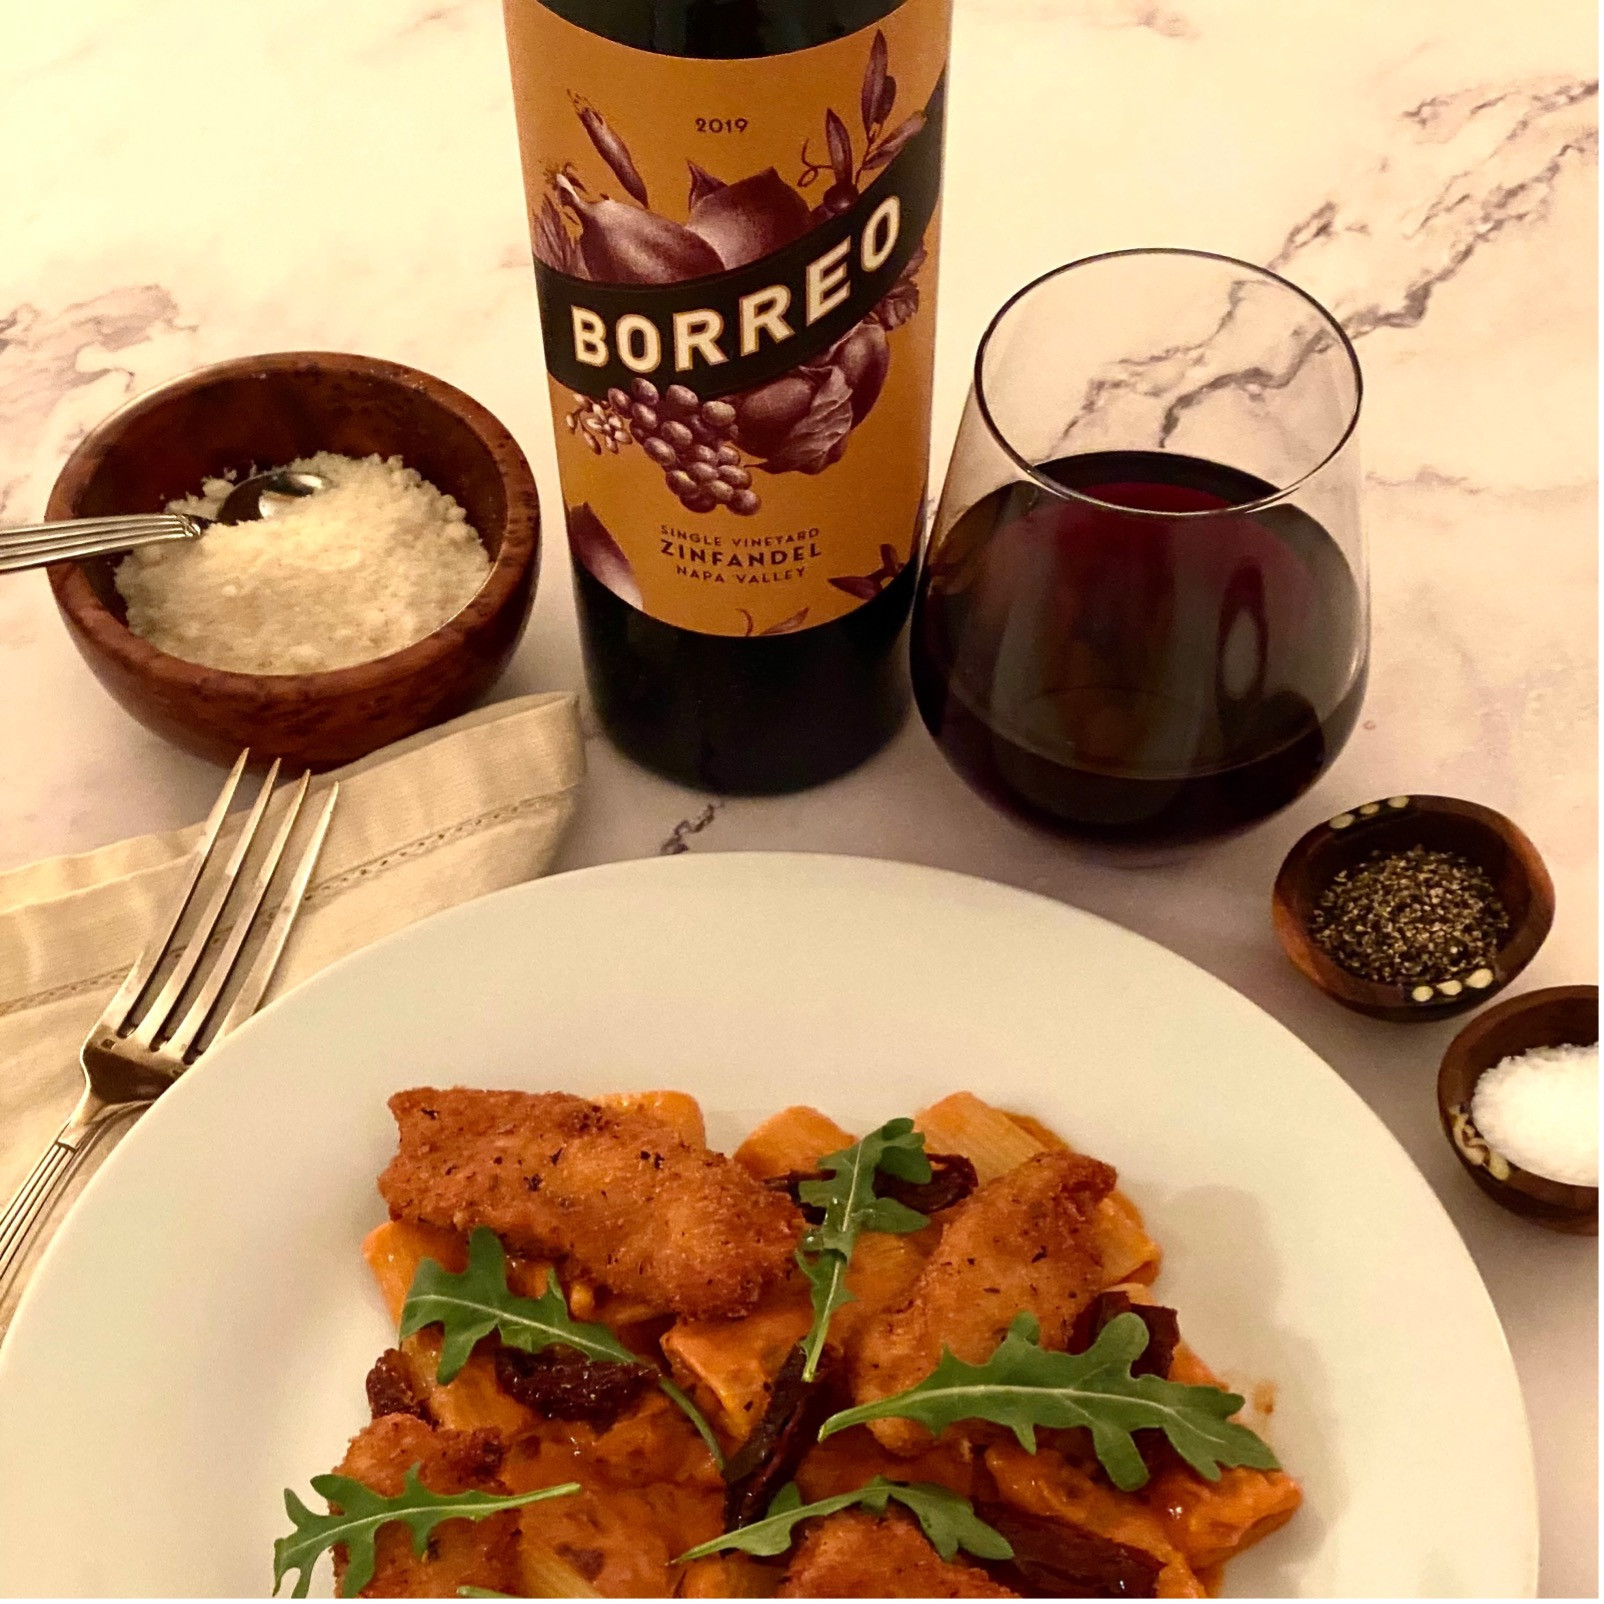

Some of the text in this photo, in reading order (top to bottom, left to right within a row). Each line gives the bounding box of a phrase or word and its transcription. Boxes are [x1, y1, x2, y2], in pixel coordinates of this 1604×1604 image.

[695, 118, 749, 134] 2019
[570, 195, 901, 374] BORREO
[660, 525, 820, 547] SINGLE VINEYARD
[660, 538, 822, 567] ZINFANDEL
[676, 565, 806, 584] NAPA VALLEY
